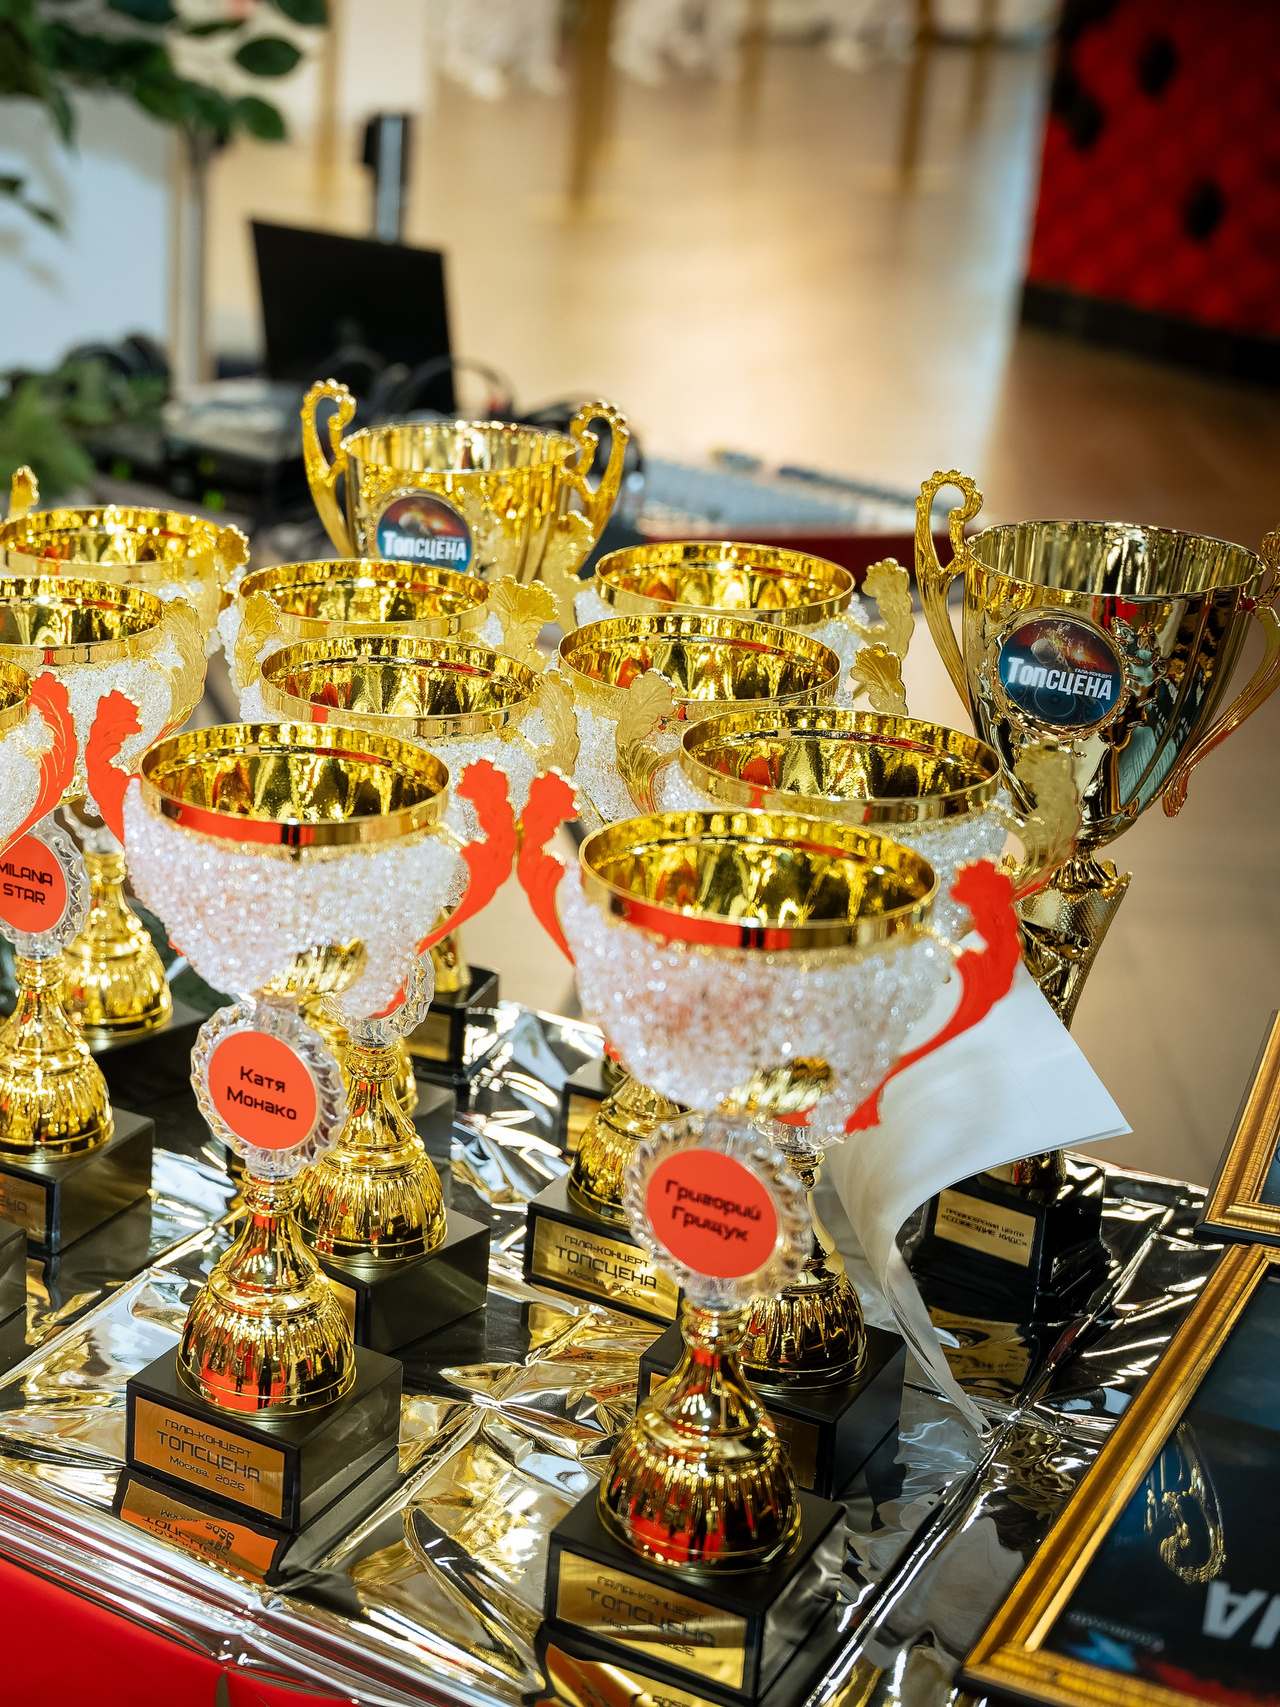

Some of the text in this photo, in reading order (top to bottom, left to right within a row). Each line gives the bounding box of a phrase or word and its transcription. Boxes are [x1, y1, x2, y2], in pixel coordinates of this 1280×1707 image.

[3, 883, 45, 905] STAR
[240, 1066, 285, 1093] Катя
[227, 1086, 297, 1120] Монако
[556, 1245, 657, 1289] ТОПСЦЕНА
[564, 1234, 649, 1268] ГАЛА-КОНЦЕРТ
[157, 1430, 260, 1482] ТОПСЦЕНА
[165, 1418, 252, 1458] ГАЛА-КОНЦЕРТ
[169, 1455, 246, 1492] Москва, 2026
[586, 1587, 716, 1647] ТОПСЦЕНА
[597, 1576, 706, 1621] ГАЛА-КОНЦЕРТ
